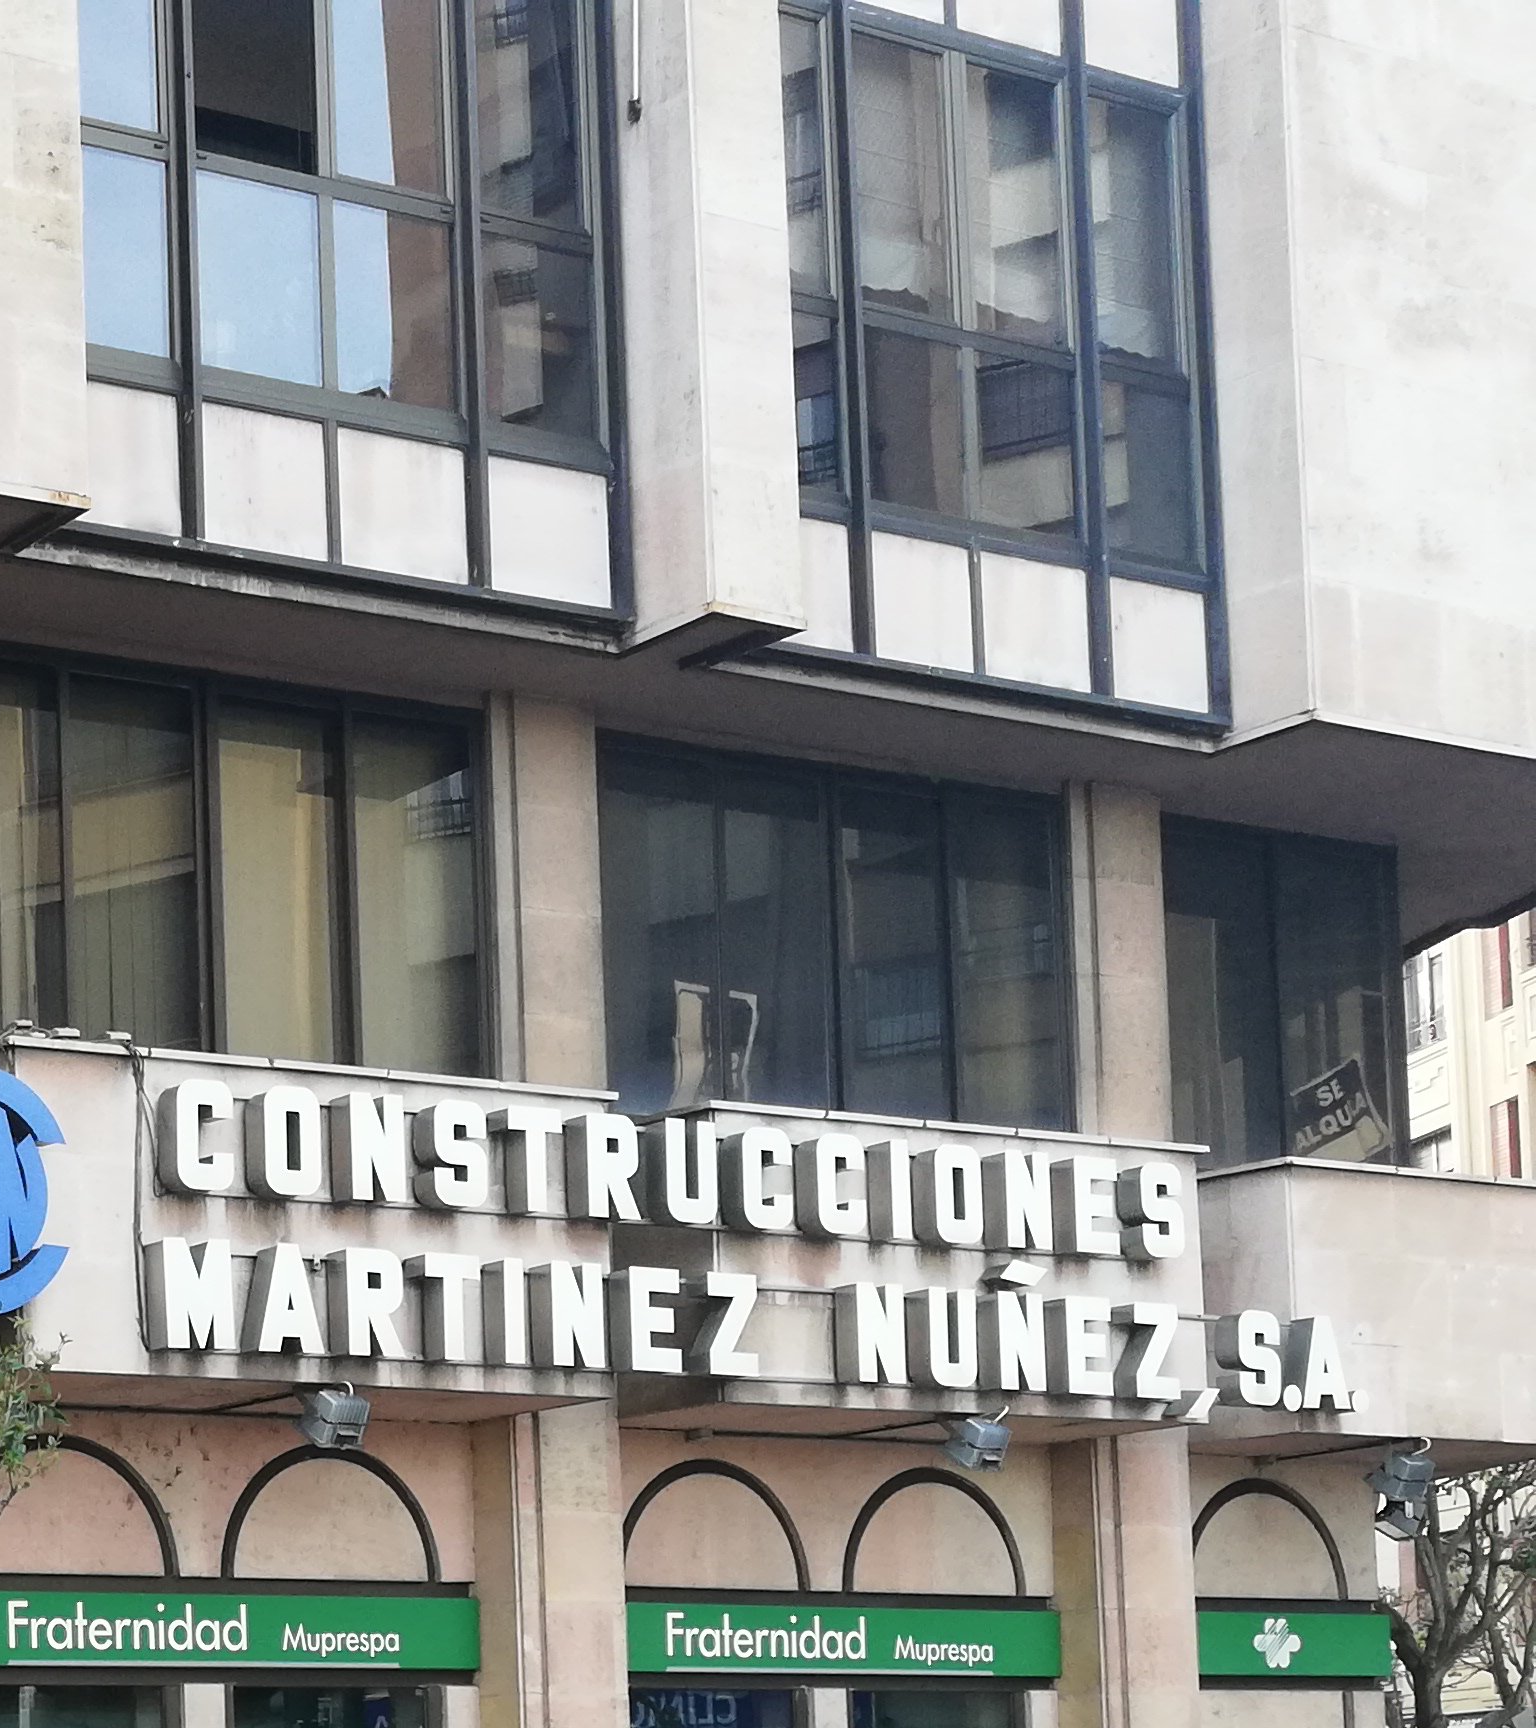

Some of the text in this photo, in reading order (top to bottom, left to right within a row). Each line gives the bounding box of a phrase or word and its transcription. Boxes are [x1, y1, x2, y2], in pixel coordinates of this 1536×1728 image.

[1315, 1078, 1344, 1107] SE
[160, 1078, 1186, 1259] CONSTRUCCIONES
[148, 1236, 760, 1378] MARTINEZ
[1218, 1309, 1370, 1413] S.A.
[6, 1599, 400, 1658] Fraternidad Muprespa
[665, 1611, 994, 1667] Fraternidad Muprespa
